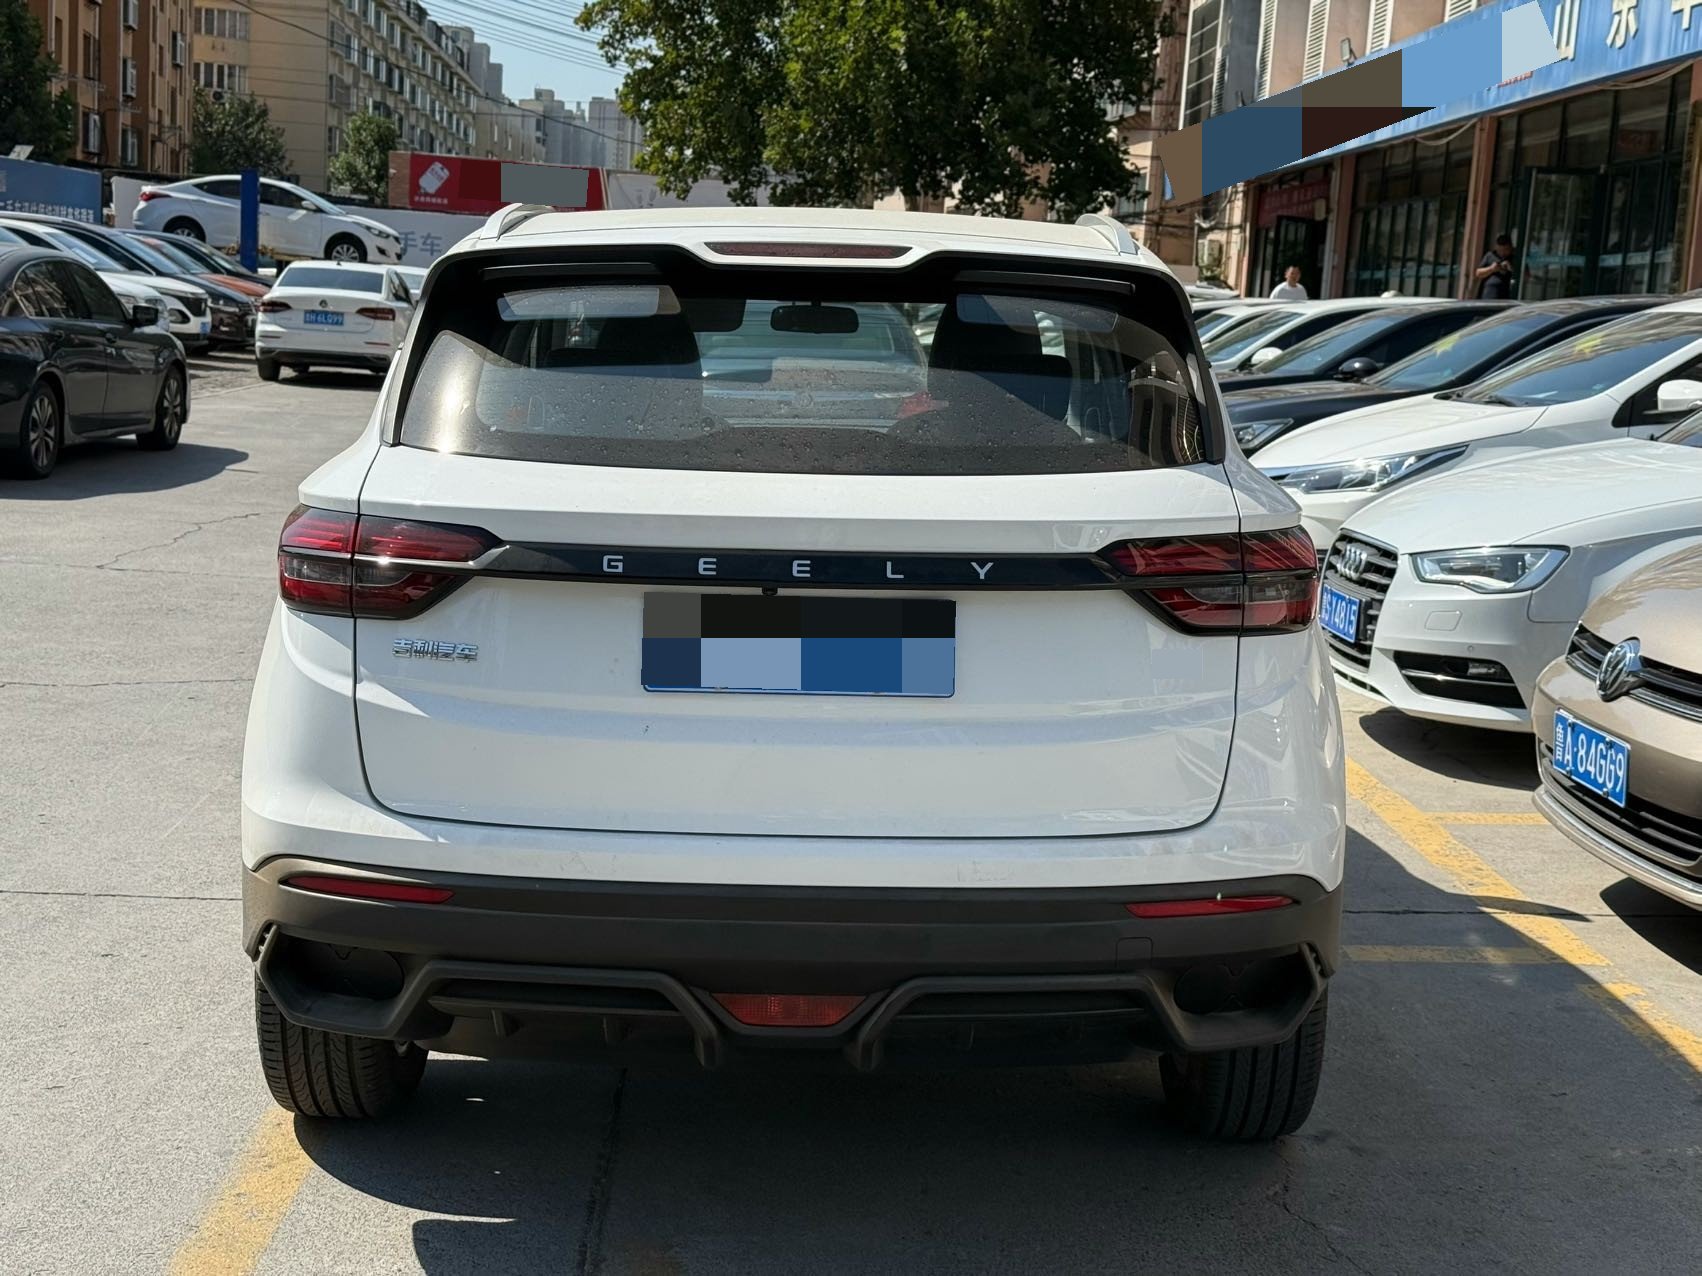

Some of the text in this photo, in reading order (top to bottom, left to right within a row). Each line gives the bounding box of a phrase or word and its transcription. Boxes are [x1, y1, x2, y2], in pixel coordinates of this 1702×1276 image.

[602, 555, 993, 580] GEELY
[392, 639, 478, 663] 吉利汽车
